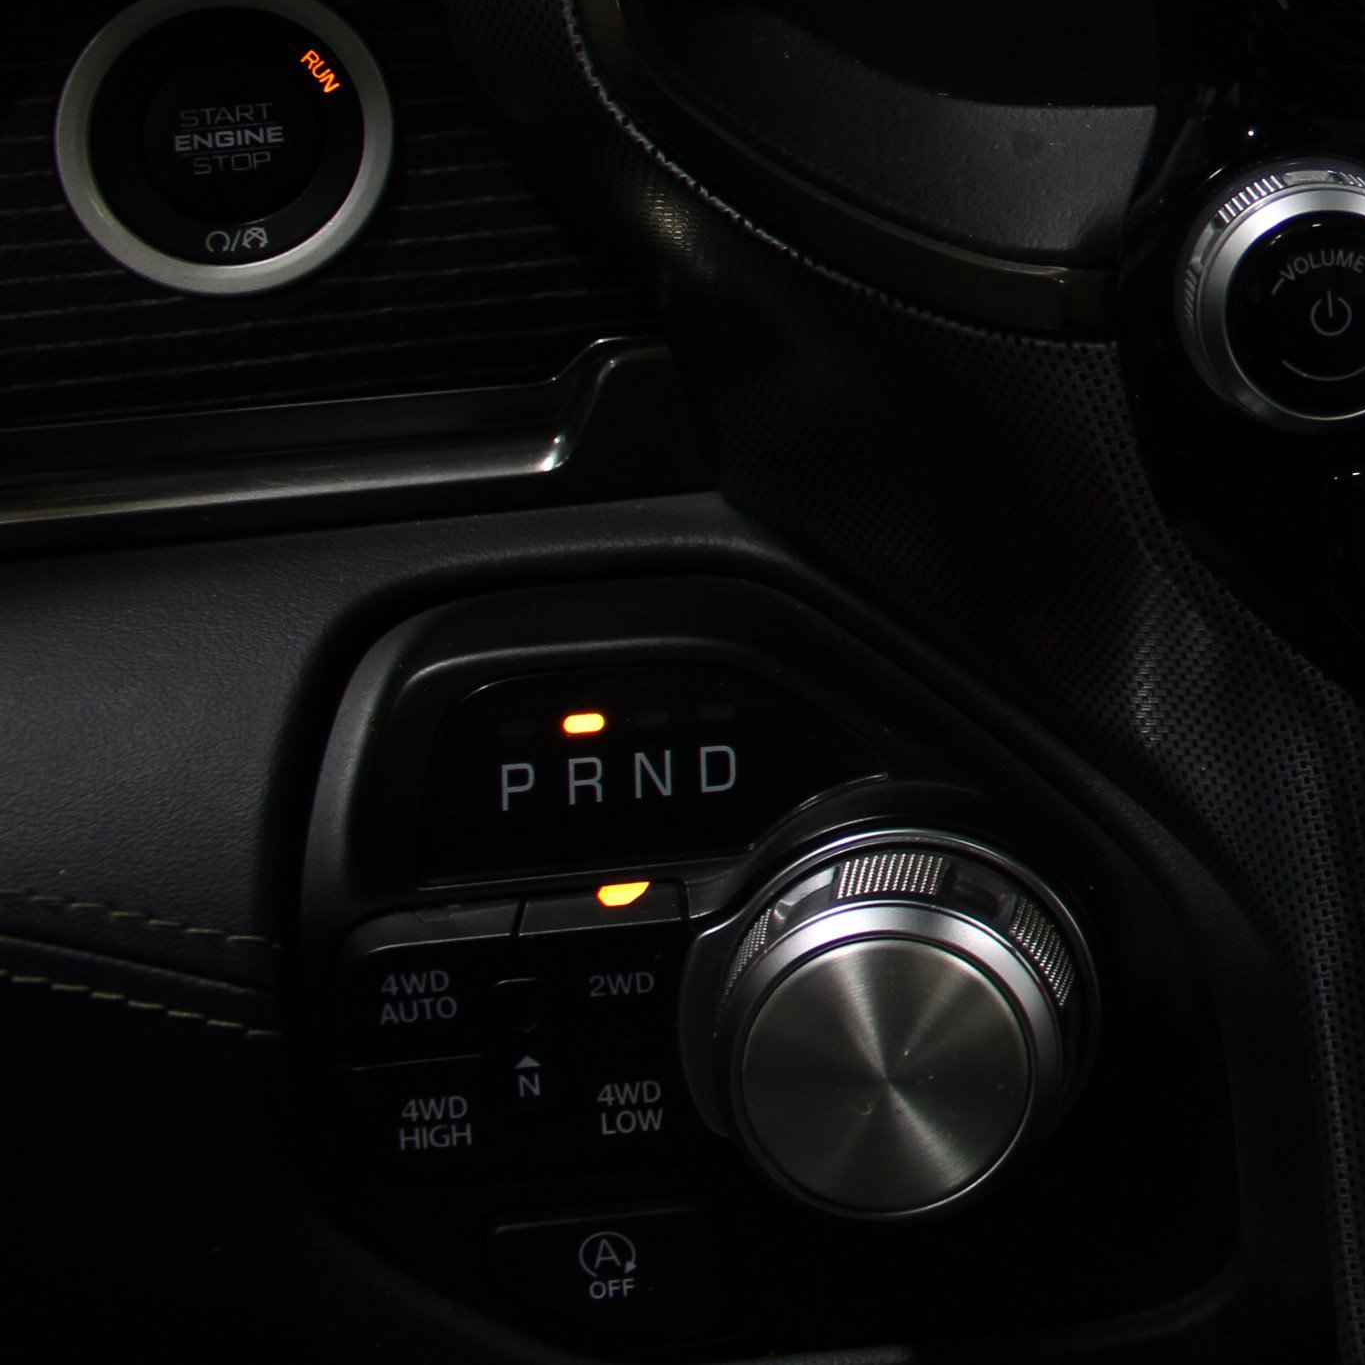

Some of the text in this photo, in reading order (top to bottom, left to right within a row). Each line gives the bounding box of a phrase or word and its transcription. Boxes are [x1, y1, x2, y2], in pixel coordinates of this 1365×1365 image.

[300, 49, 341, 94] RUN
[180, 102, 276, 128] START
[174, 126, 284, 153] ENGINE
[192, 151, 272, 176] STOP
[501, 744, 737, 812] P R N D
[381, 970, 451, 998] 4WD
[588, 971, 655, 998] 2WD
[380, 995, 458, 1026] AUTO
[518, 1073, 541, 1098] N
[597, 1080, 662, 1107] 4WD
[401, 1095, 468, 1122] 4WD
[601, 1108, 663, 1136] LOW
[398, 1123, 472, 1151] HIGH
[589, 1277, 635, 1300] OFF
